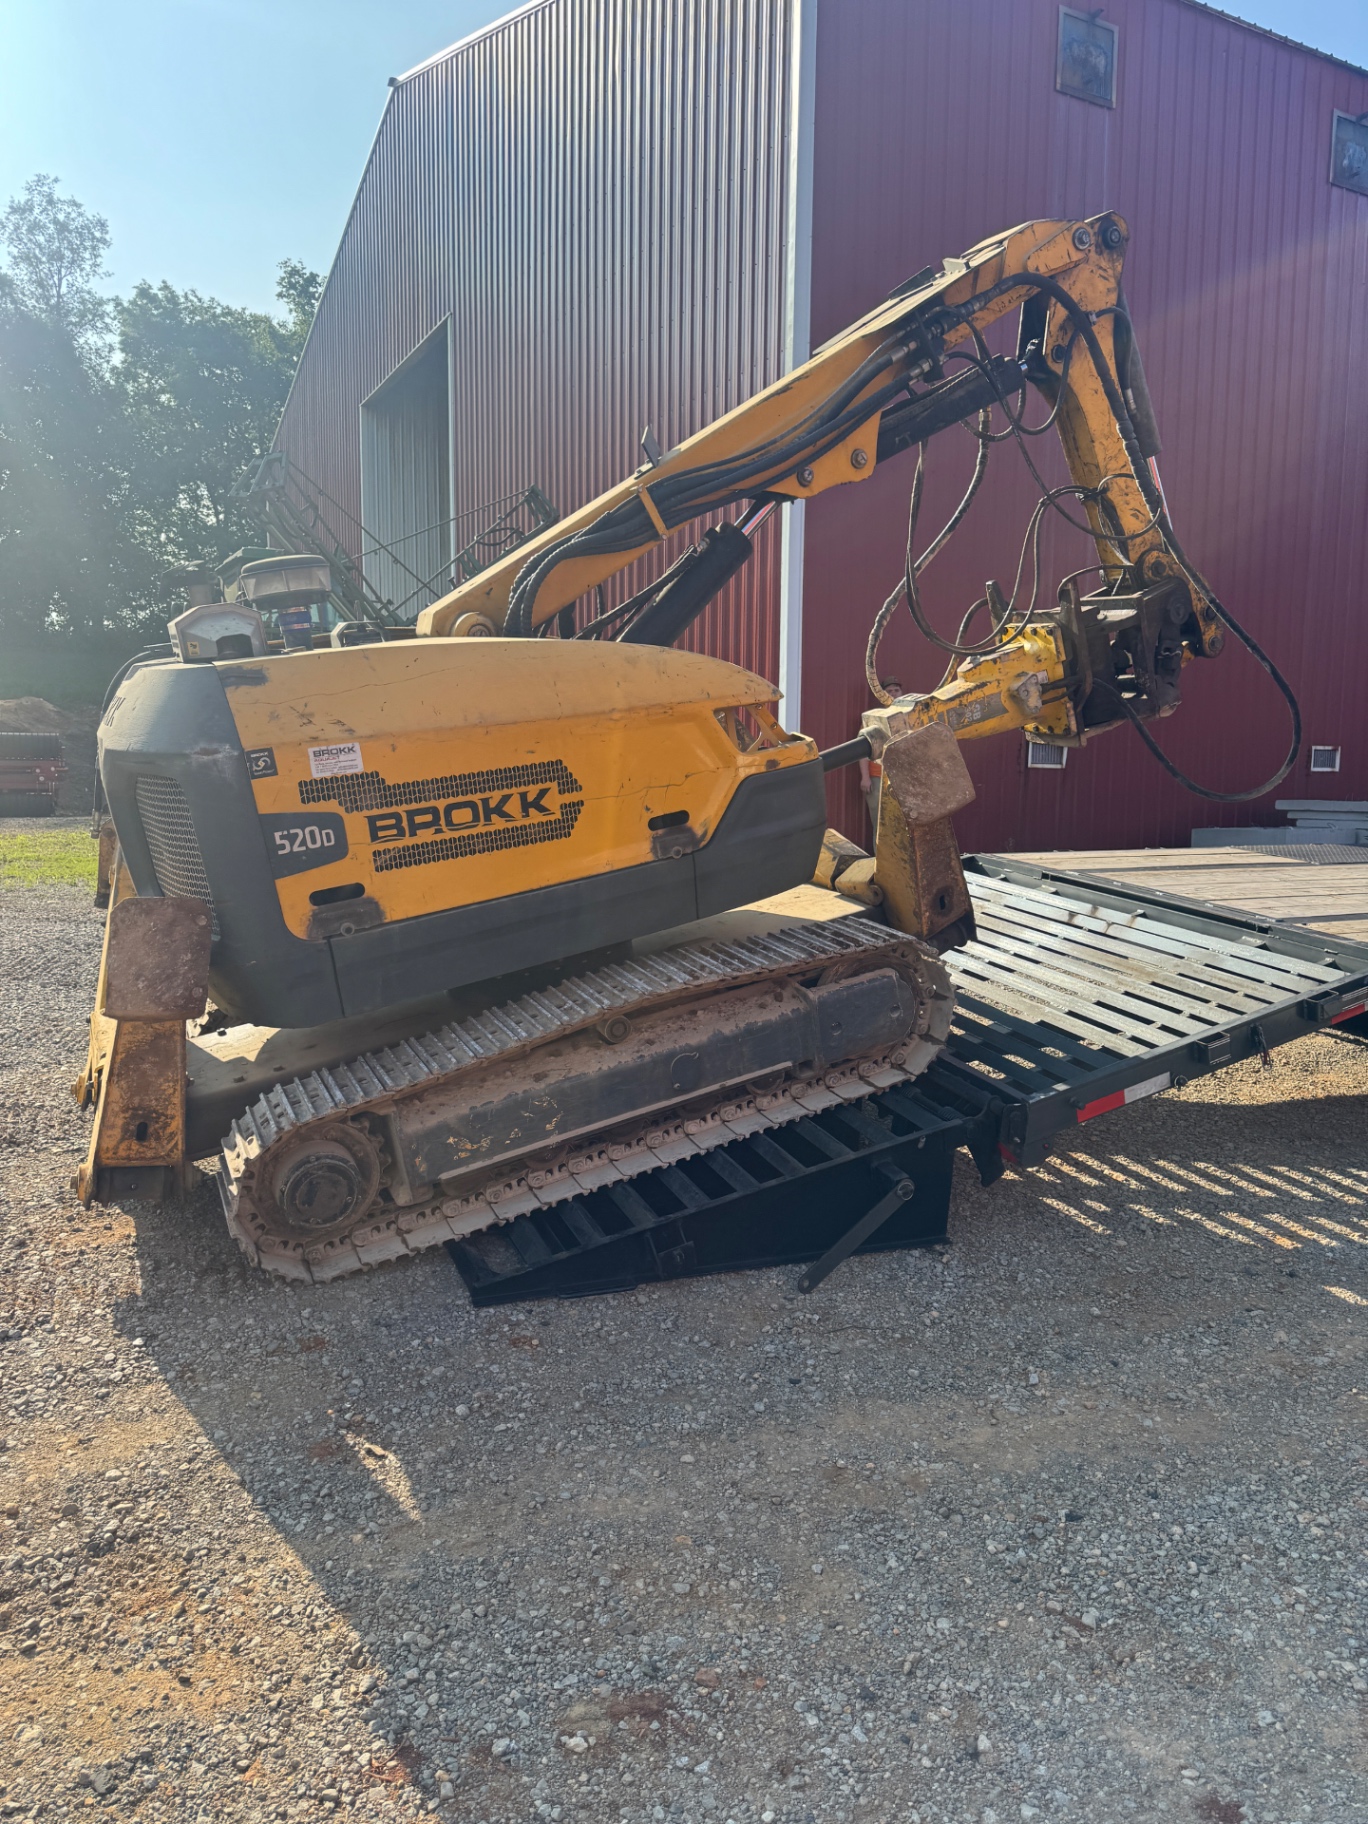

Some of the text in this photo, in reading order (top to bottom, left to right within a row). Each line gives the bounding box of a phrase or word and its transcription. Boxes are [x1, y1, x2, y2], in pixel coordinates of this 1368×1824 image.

[313, 746, 356, 757] BROKK
[363, 787, 556, 843] BROKK
[273, 825, 335, 855] 520D
